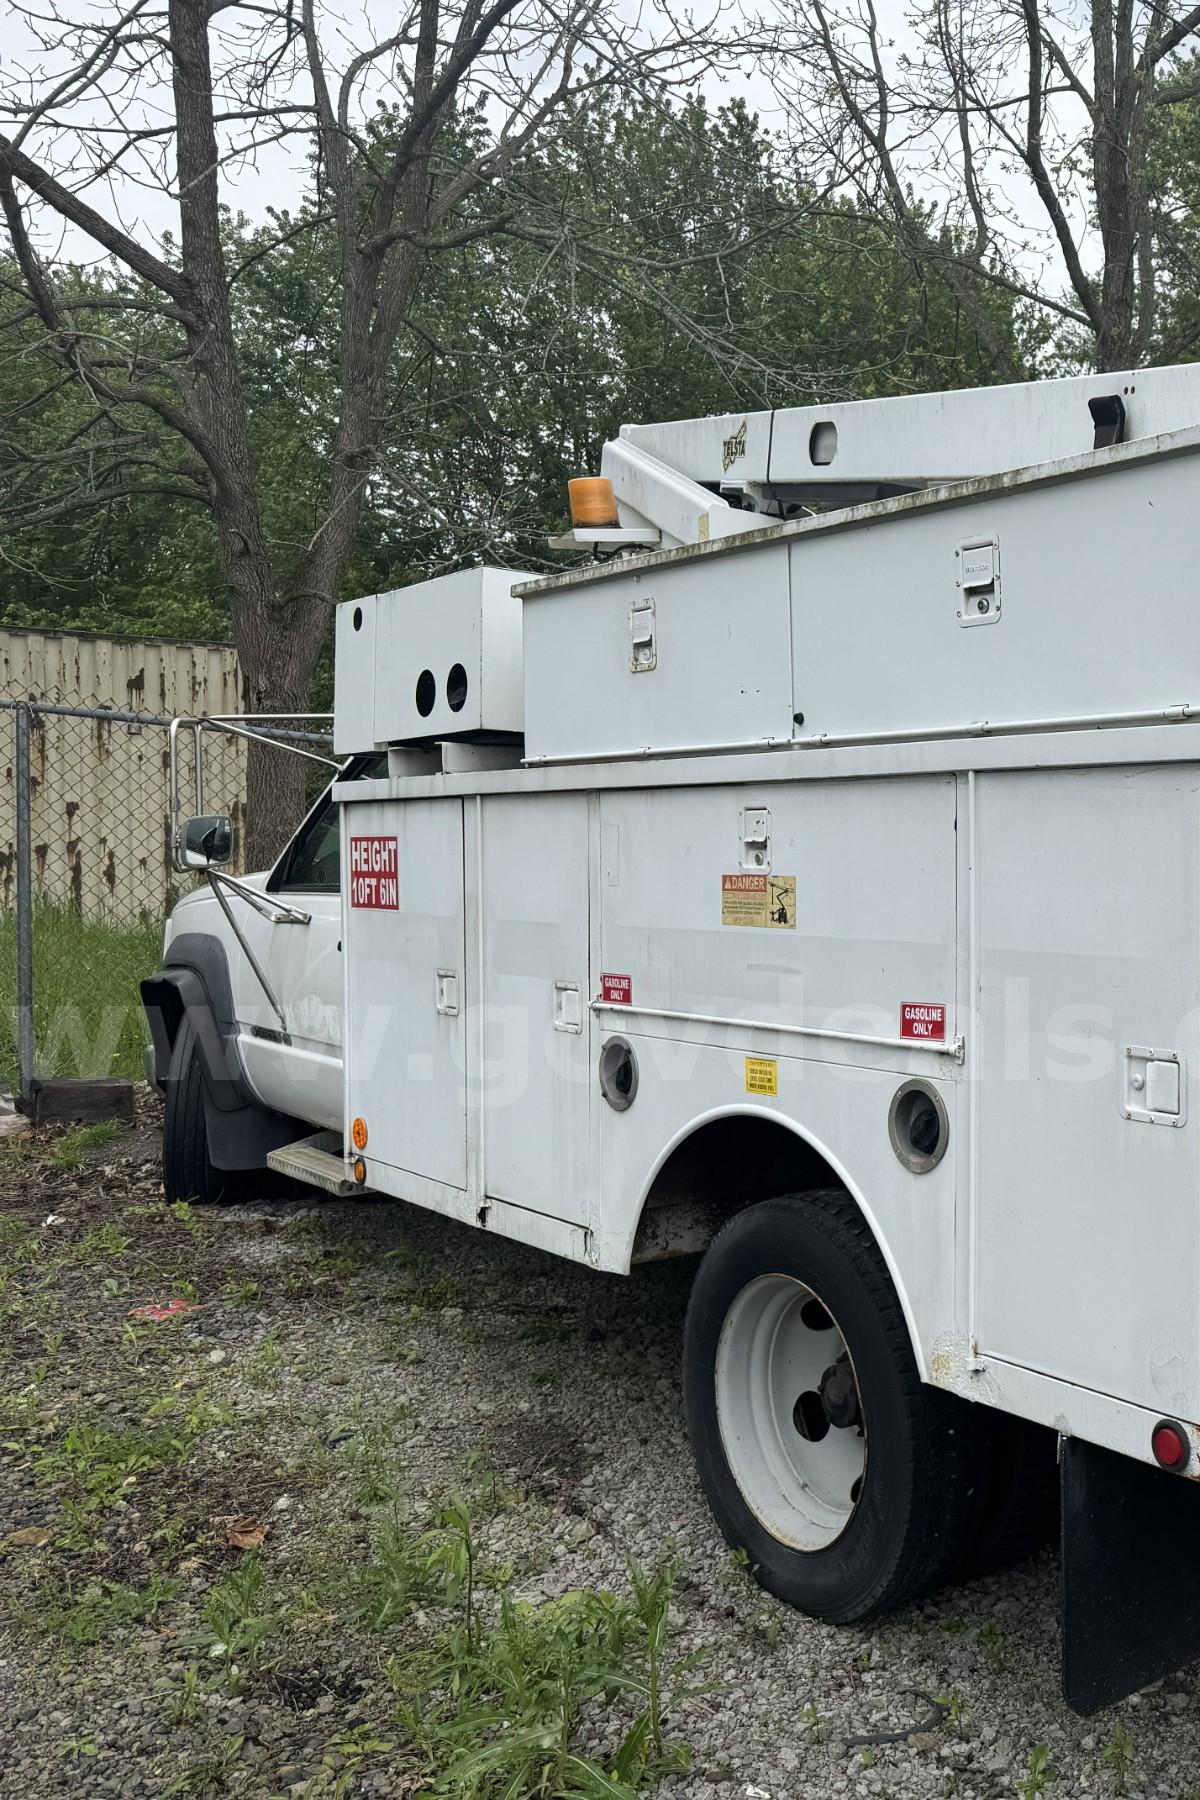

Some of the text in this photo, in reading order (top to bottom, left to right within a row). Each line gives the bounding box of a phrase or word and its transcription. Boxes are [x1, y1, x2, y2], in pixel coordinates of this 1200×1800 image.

[723, 440, 745, 457] TELSTA
[352, 840, 397, 873] HEIGHT
[732, 876, 765, 890] DANGER
[352, 877, 397, 906] 10FT 6IN
[604, 976, 630, 989] GASOLINE
[610, 989, 624, 1001] ONLY
[904, 1007, 942, 1022] GASOLINE
[912, 1022, 933, 1036] ONLY
